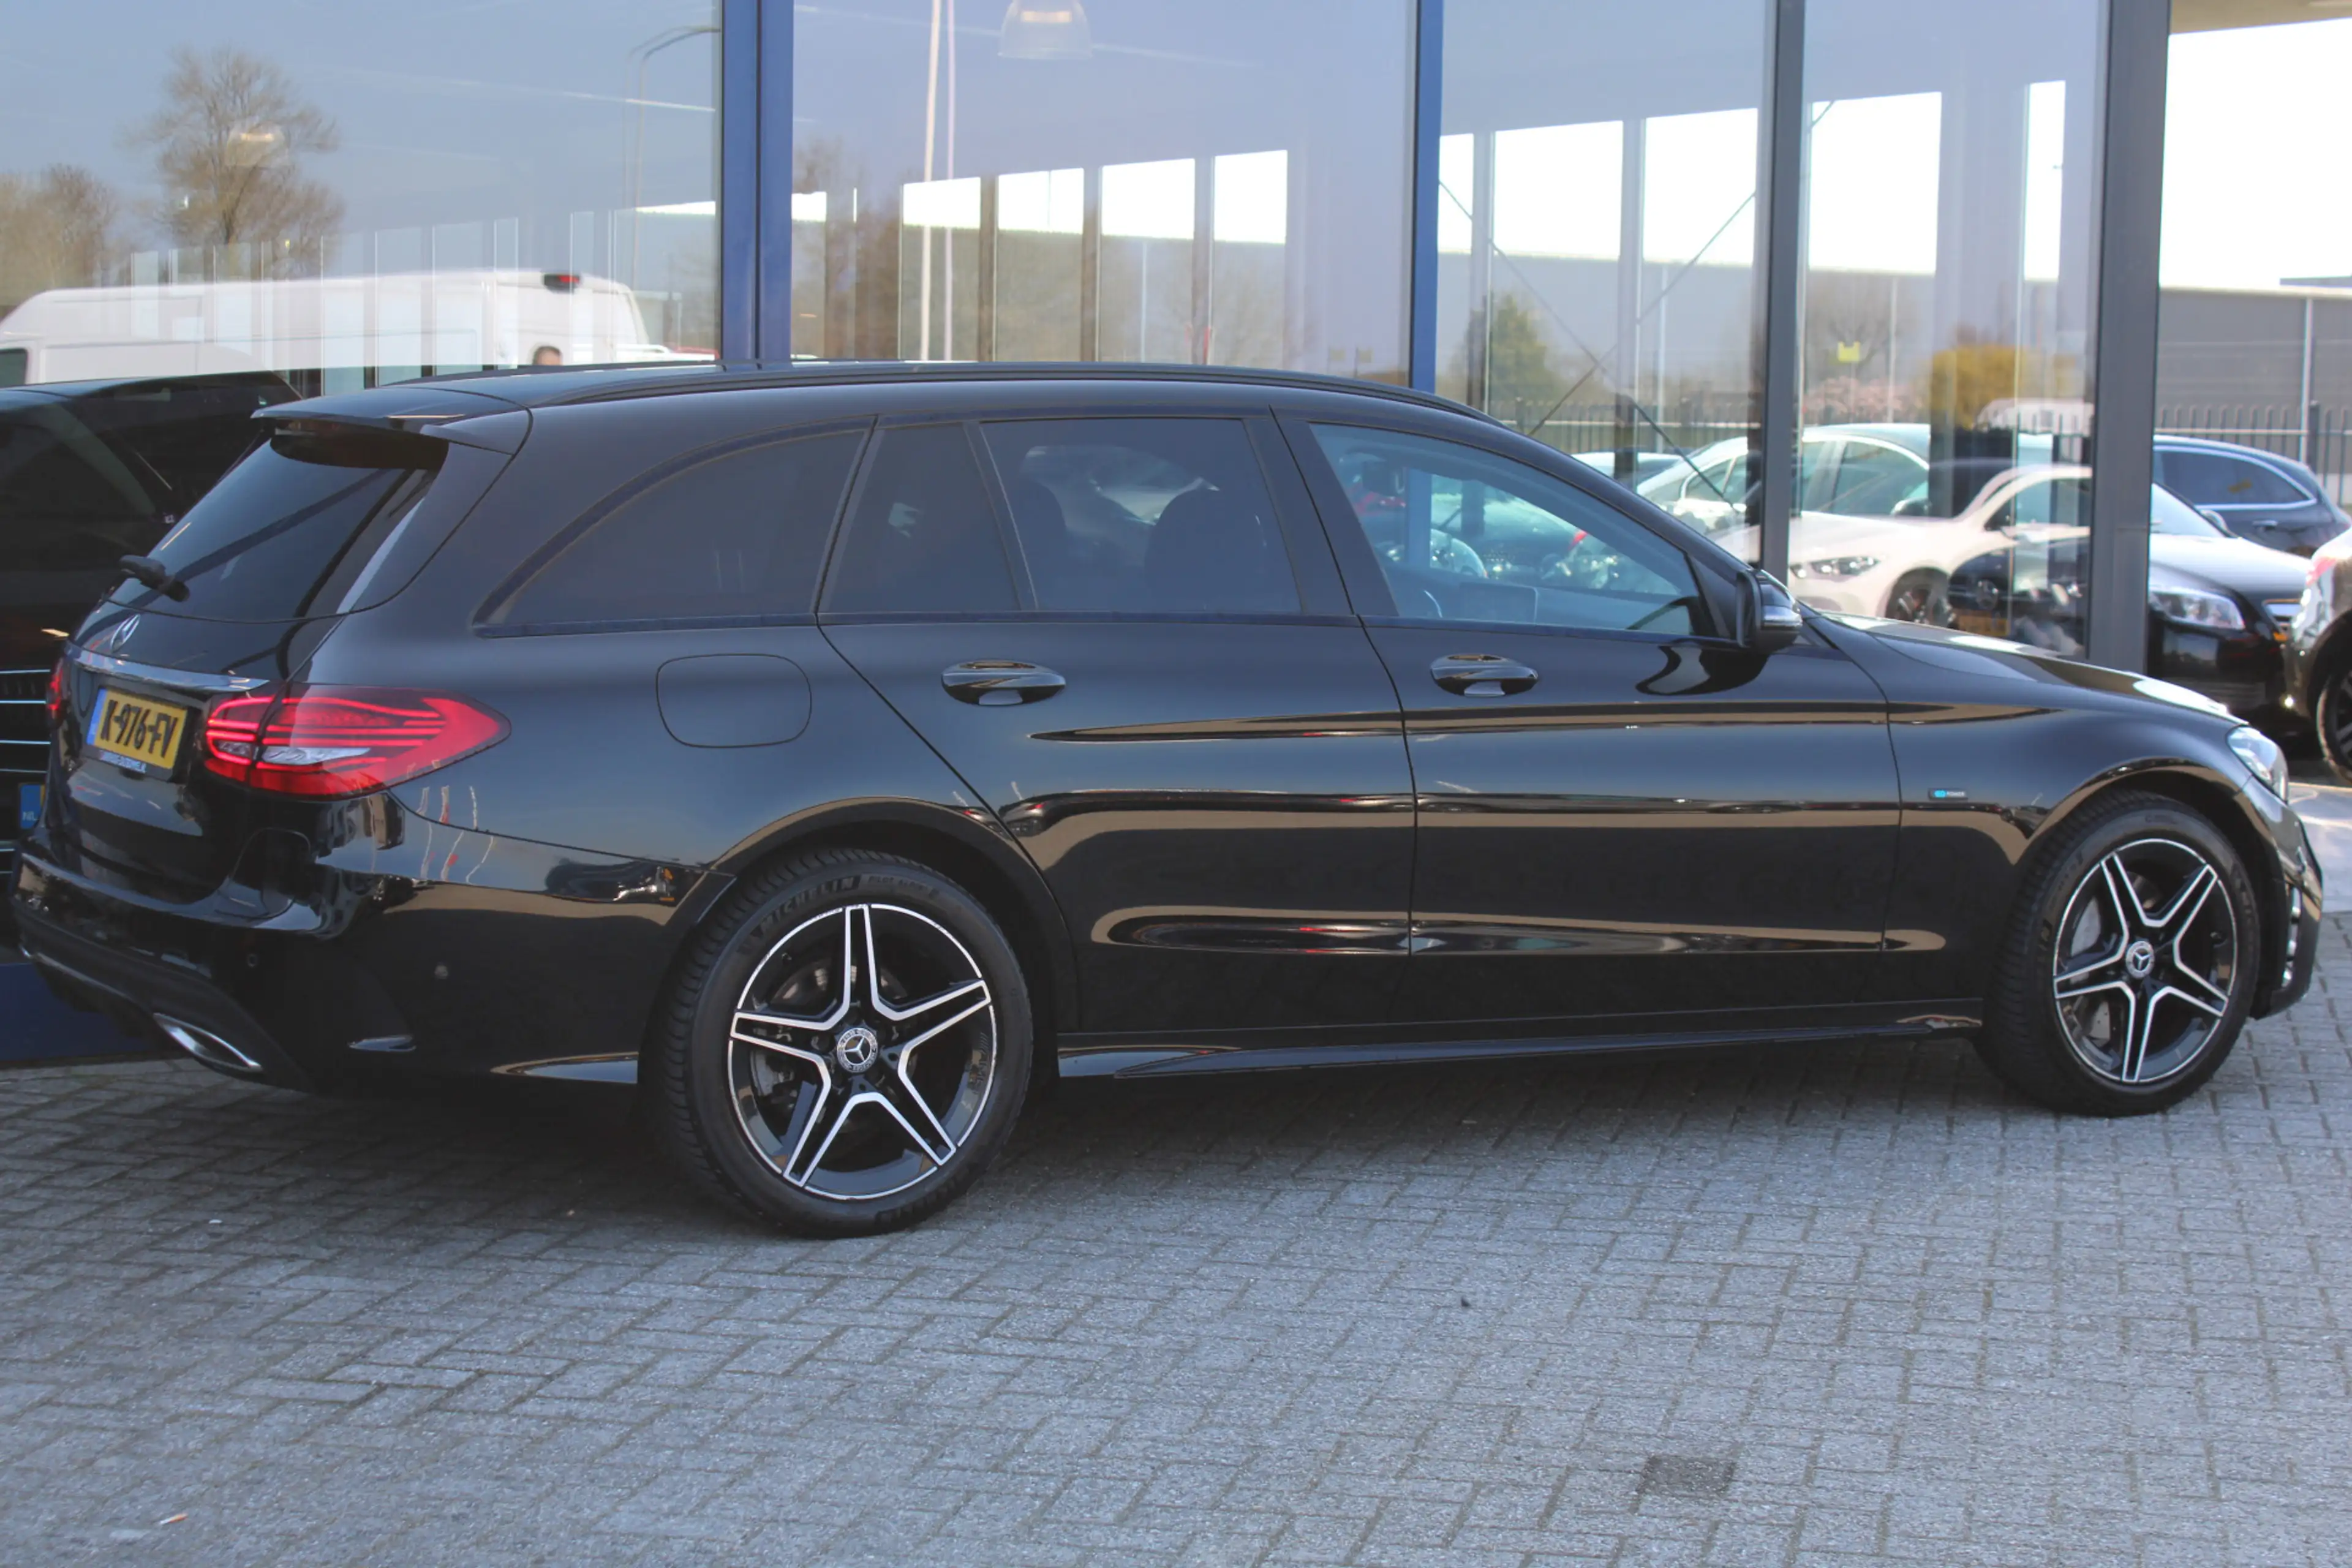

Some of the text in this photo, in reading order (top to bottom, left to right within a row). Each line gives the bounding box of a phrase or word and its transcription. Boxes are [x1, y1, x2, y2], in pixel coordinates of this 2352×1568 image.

[100, 699, 178, 758] K-976-FV
[23, 812, 37, 821] NL
[759, 876, 856, 934] MICHELIN
